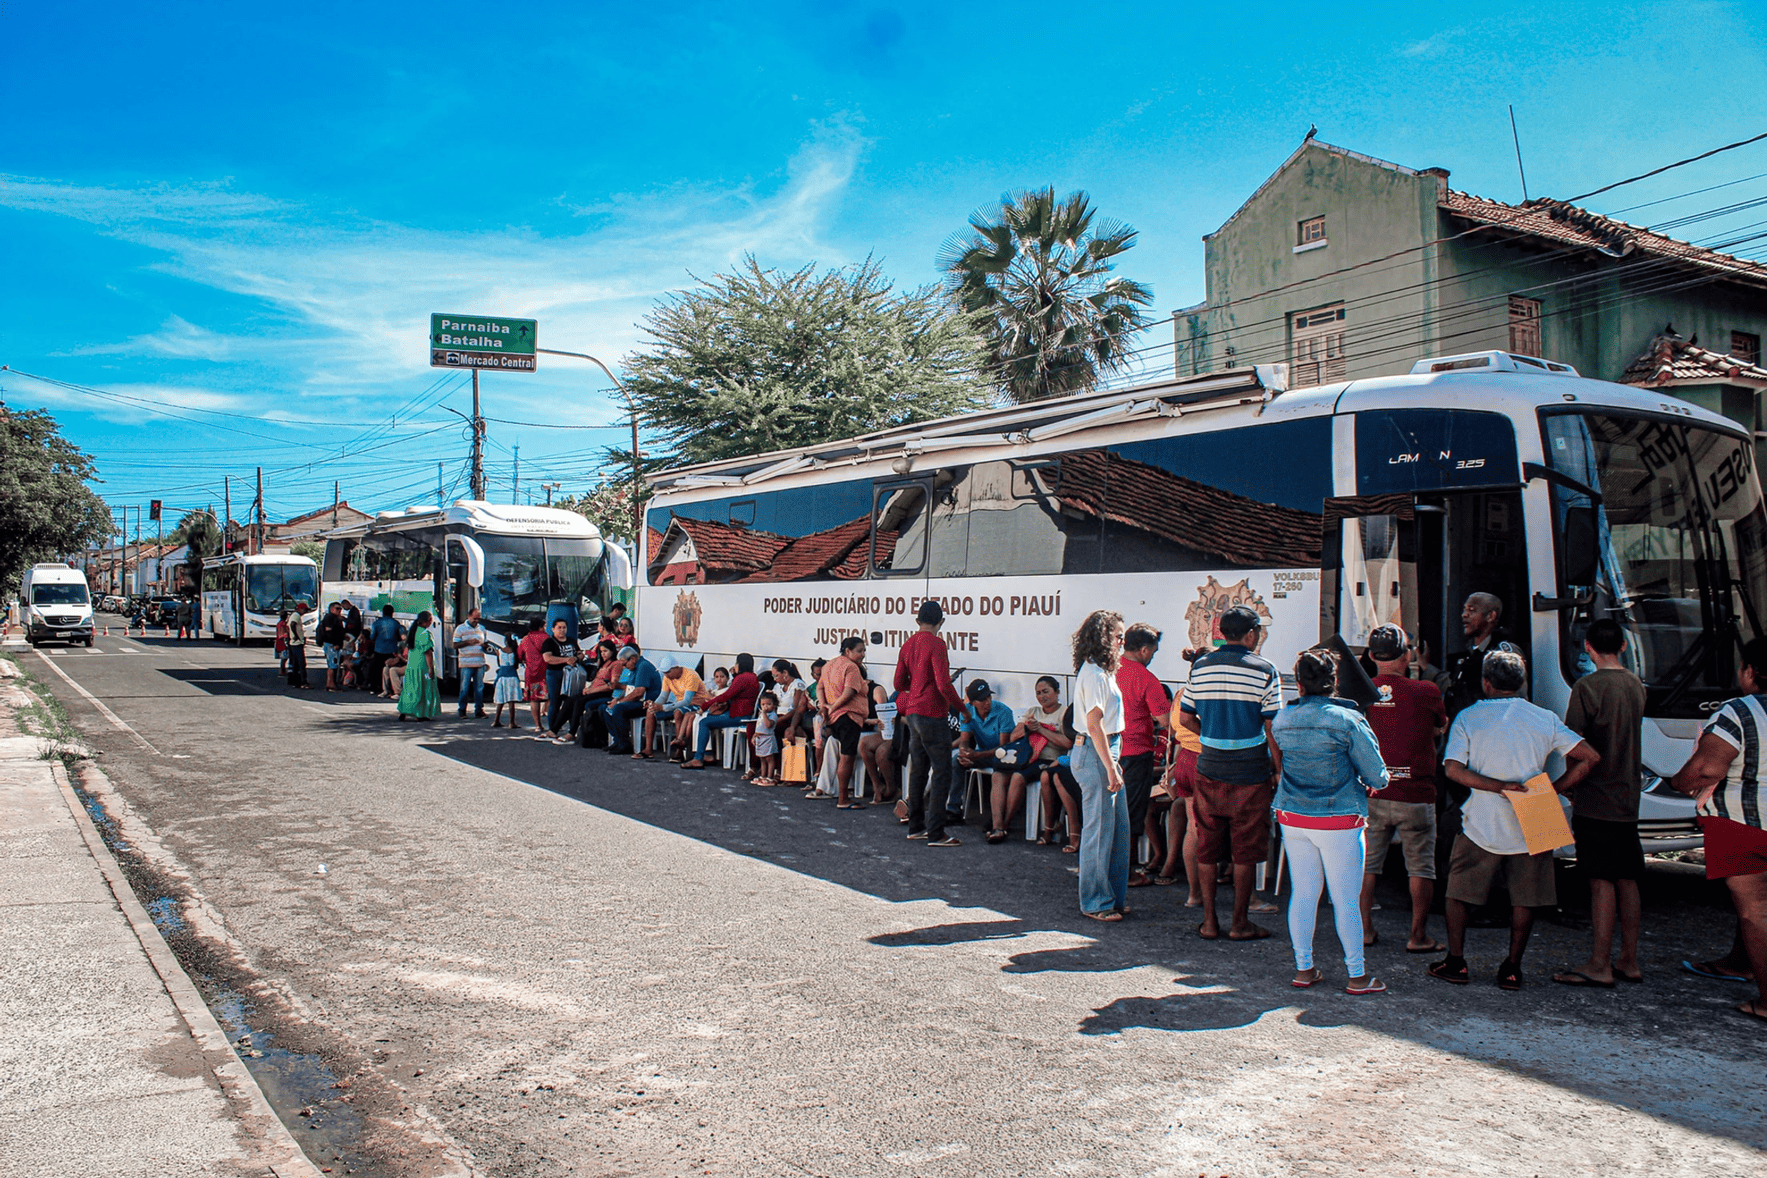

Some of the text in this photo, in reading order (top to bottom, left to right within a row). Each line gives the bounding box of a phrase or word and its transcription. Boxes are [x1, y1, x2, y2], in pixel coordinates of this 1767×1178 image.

[441, 334, 503, 348] Batalha
[460, 354, 534, 369] Mercado Central
[764, 589, 1061, 616] PODER JUDICIÁRIO DO EADO DO PIAUÍ
